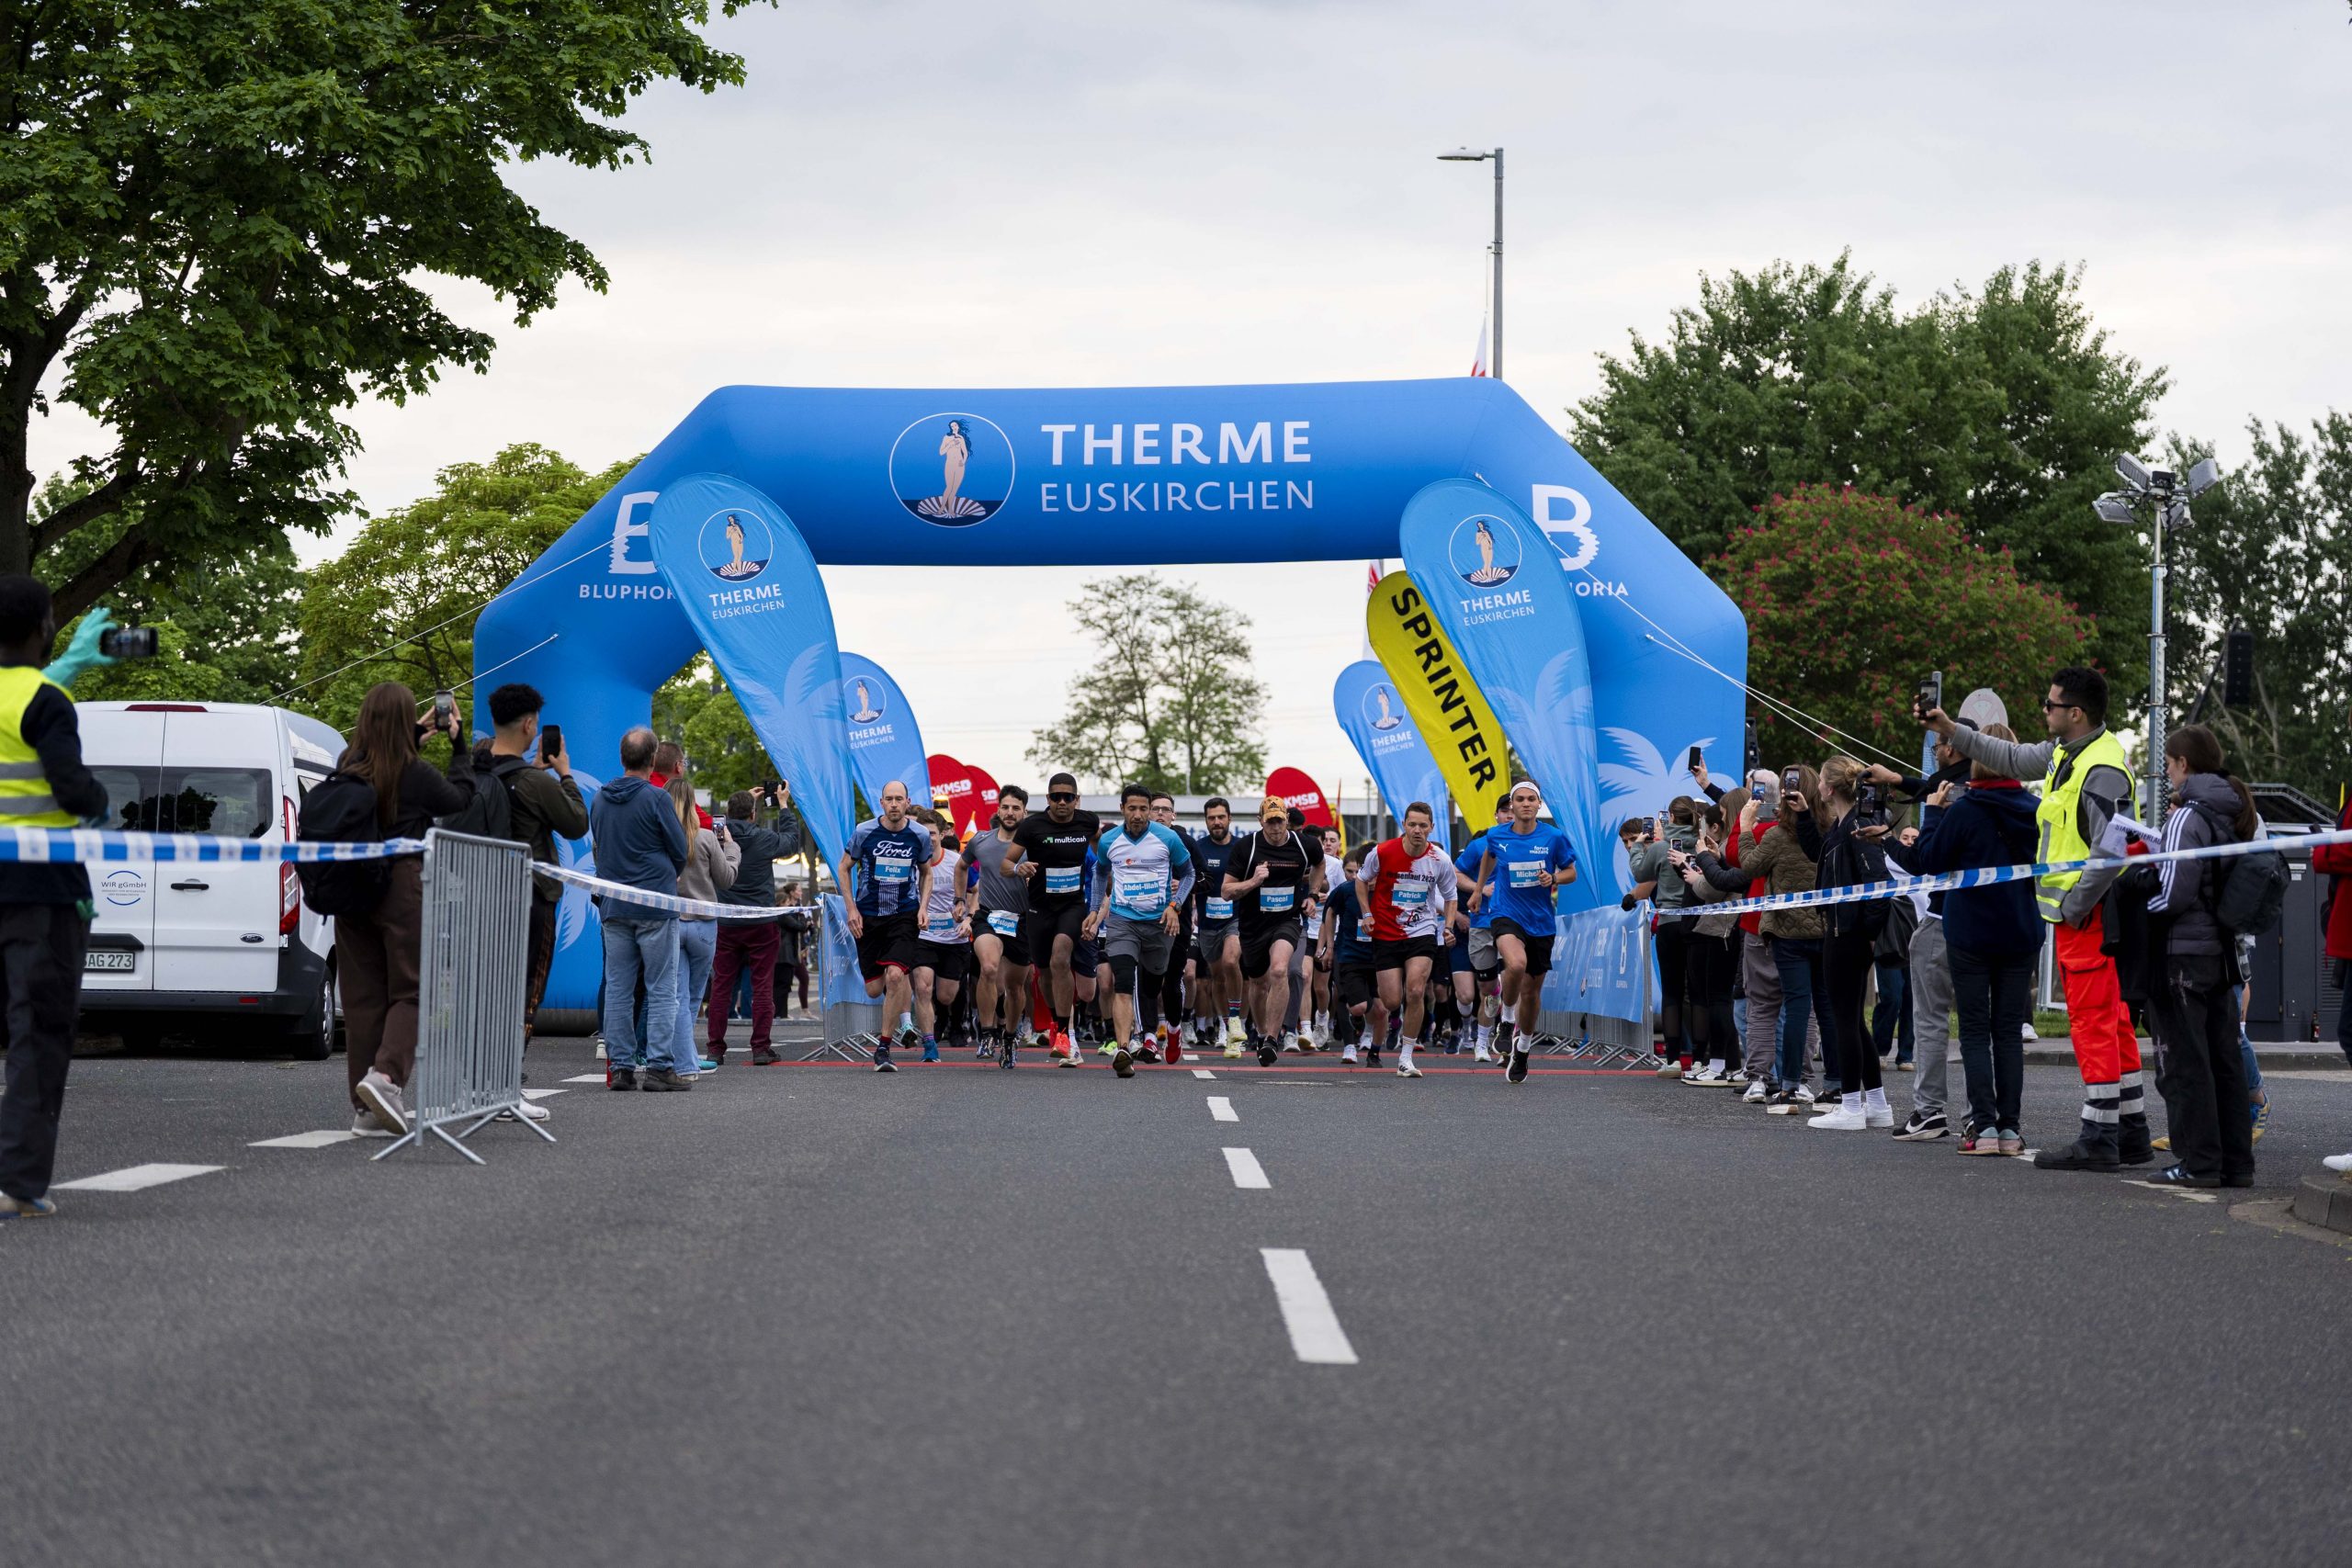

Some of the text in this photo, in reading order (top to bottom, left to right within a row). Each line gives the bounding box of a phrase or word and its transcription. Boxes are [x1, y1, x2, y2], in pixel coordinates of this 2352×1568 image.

[1040, 421, 1312, 466] THERME
[1041, 480, 1314, 512] EUSKIRCHEN
[1532, 484, 1600, 571] B
[708, 583, 783, 607] THERME
[1569, 581, 1629, 596] ORIA
[1461, 589, 1532, 613] THERME
[712, 600, 786, 620] EUSKIRCHEN
[1464, 605, 1535, 626] EUSKIRCHEN
[1391, 587, 1497, 792] SPRINTER
[848, 724, 893, 740] THERME
[1371, 730, 1412, 748] THERME
[850, 735, 896, 750] EUSKIRCHEN
[1283, 793, 1308, 808] KMS
[1055, 835, 1087, 843] multicash
[873, 840, 912, 857] Ford
[885, 865, 901, 874] Felix
[1398, 891, 1421, 899] Patrick
[86, 953, 132, 968] AG 273
